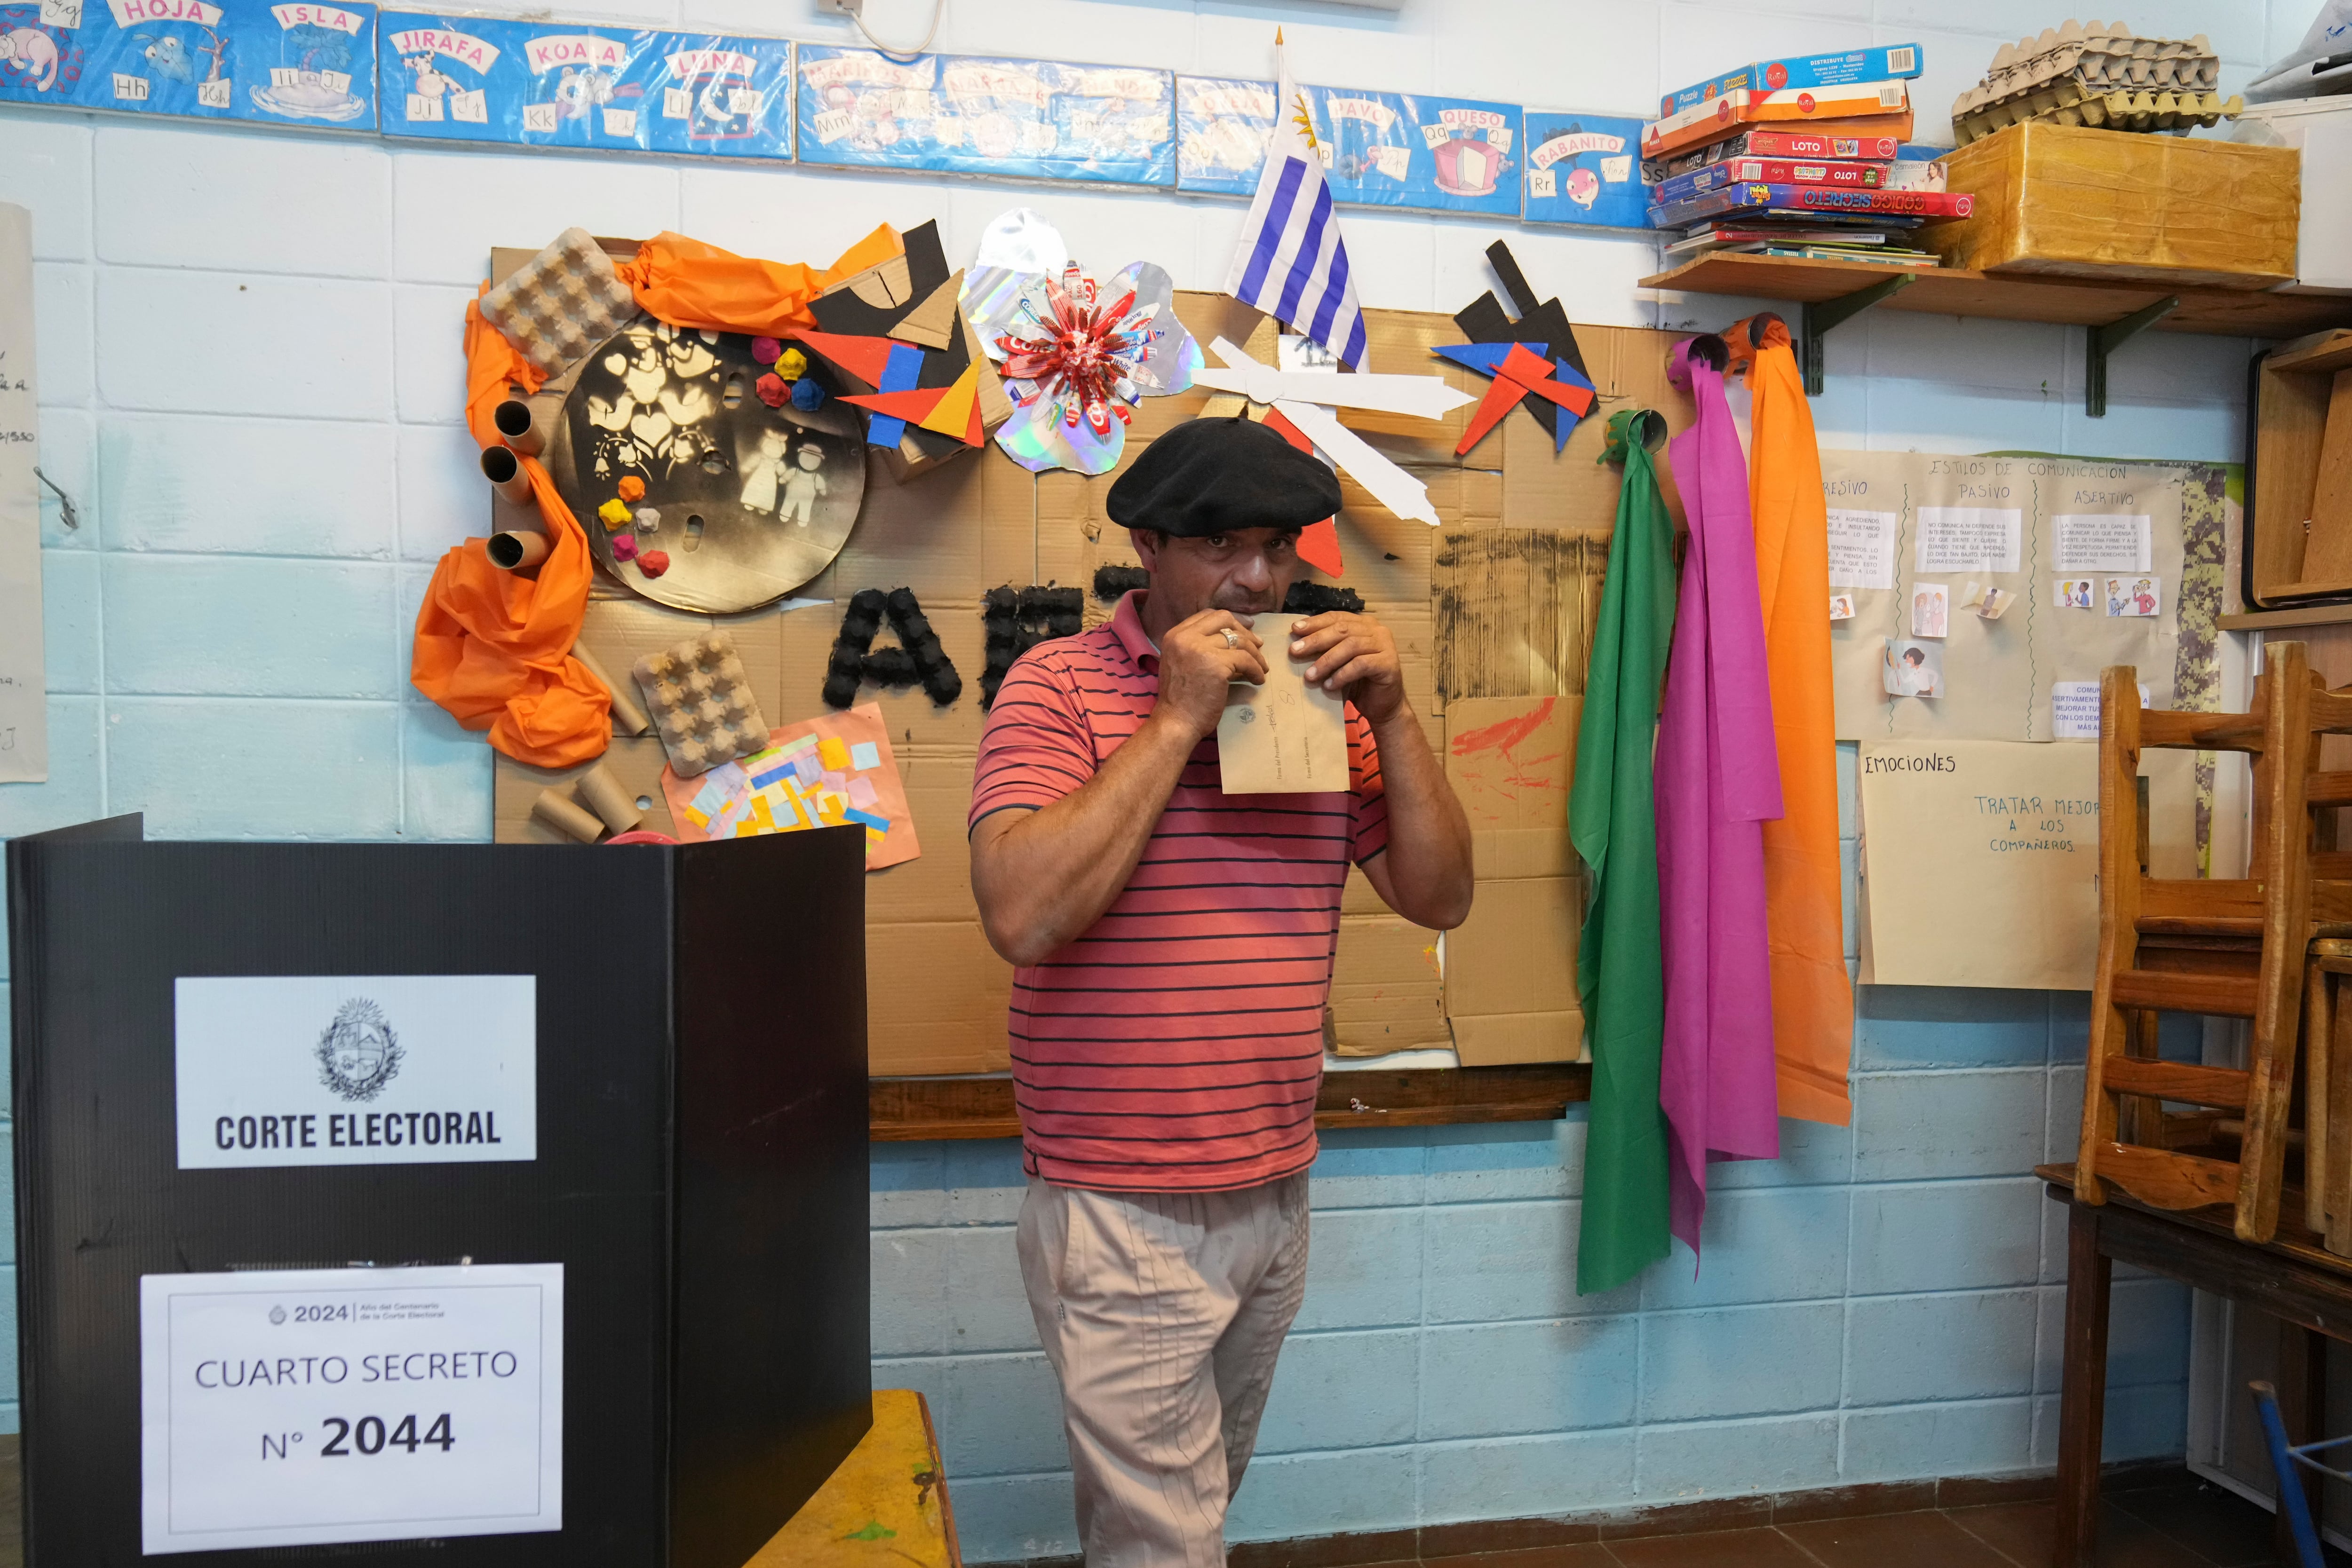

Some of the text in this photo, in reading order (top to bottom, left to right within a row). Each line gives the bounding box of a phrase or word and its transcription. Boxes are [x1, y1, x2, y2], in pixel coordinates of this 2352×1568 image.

[124, 0, 203, 20] HOJA
[281, 7, 347, 28] ISLA
[403, 32, 485, 65] JIRAFA
[536, 43, 616, 64] KOAA
[678, 53, 745, 74] LUNA
[1810, 57, 1844, 66] DISTRIBUYE
[1723, 73, 1748, 91] PUZZLE
[1767, 71, 1787, 82] Royal
[117, 79, 145, 97] Hh
[1679, 90, 1698, 104] Puzzle
[1798, 98, 1814, 107] Royal
[414, 99, 431, 119] Jj
[1334, 102, 1384, 122] PAVO
[529, 111, 553, 128] Kk
[1444, 111, 1501, 127] QUESO
[1425, 127, 1447, 141] Qq
[1537, 136, 1619, 167] RABANITO
[1792, 141, 1820, 151] LOTO
[1686, 154, 1702, 167] LOTO
[1895, 162, 1925, 171] Camaleón
[1642, 163, 1663, 182] Ss
[1714, 169, 1728, 179] Disney
[1834, 171, 1857, 180] LOTO
[1535, 178, 1549, 191] Rr
[1749, 184, 1769, 195] Royal
[1114, 358, 1131, 372] White
[1995, 462, 2012, 475] DE
[1973, 796, 2043, 816] TRATAR
[2009, 819, 2064, 832] A LOS
[1990, 838, 2075, 853] COMPAÑEROS.
[215, 1111, 501, 1150] CORTE ELECTORAL
[294, 1305, 349, 1323] 2024
[394, 1302, 439, 1311] Centenario
[382, 1312, 405, 1321] Corte
[407, 1311, 445, 1320] Electoral
[195, 1351, 517, 1388] CUARTO SECRETO
[261, 1413, 456, 1461] N° 2044
